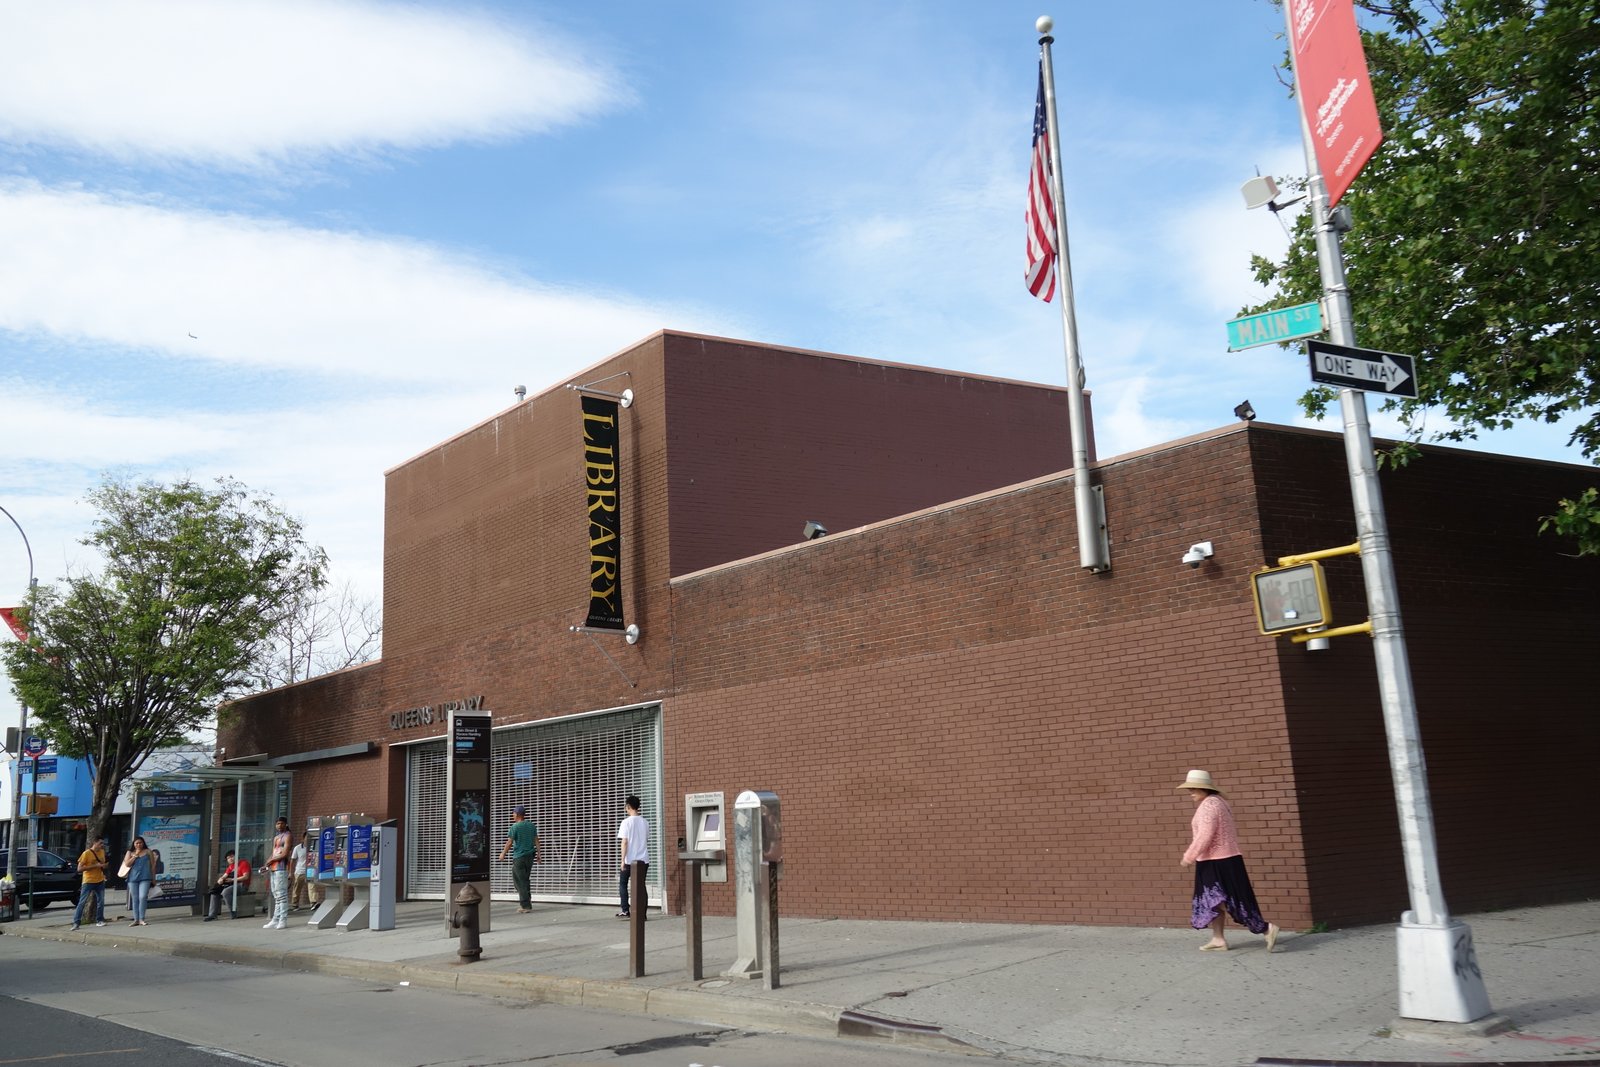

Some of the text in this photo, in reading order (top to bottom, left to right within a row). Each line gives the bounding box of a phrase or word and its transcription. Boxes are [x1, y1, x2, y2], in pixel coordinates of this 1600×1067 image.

[1237, 308, 1311, 344] MAIN ST
[1324, 355, 1354, 375] ONE
[1367, 363, 1397, 382] WAY
[582, 412, 615, 613] LIBRARY
[390, 706, 434, 730] QUEENS
